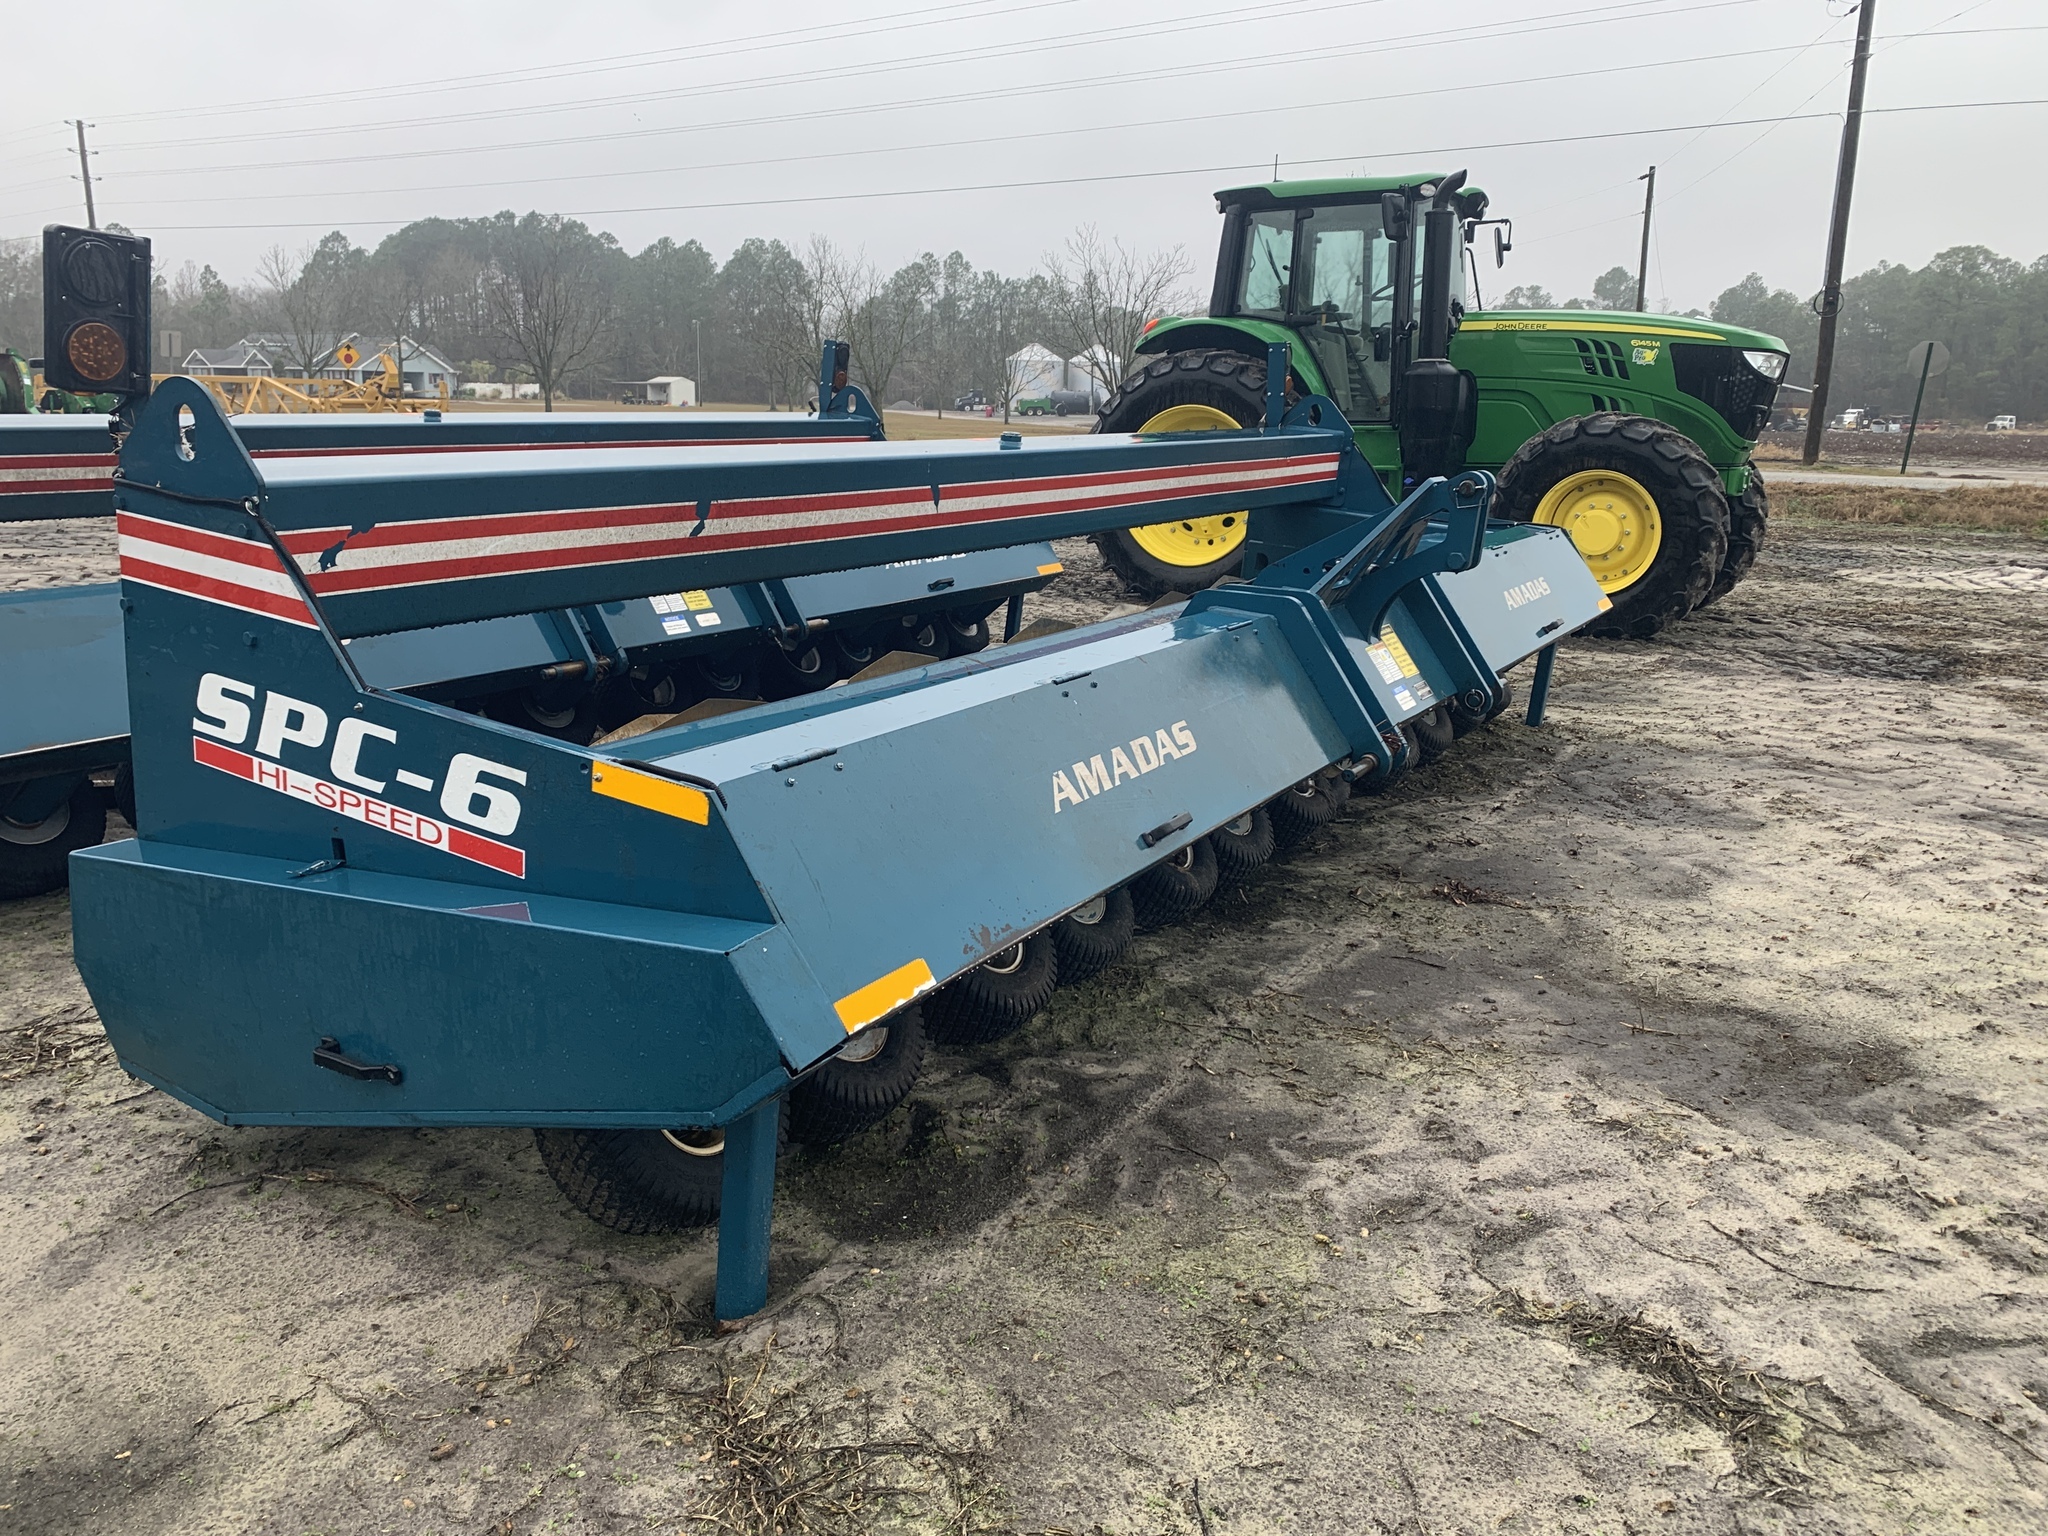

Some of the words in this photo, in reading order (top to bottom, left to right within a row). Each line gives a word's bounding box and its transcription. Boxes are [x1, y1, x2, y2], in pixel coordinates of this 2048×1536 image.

[1493, 322, 1517, 330] JOHN
[1518, 322, 1548, 330] DEERE
[1630, 339, 1661, 347] 6145M
[1503, 576, 1551, 610] AMADAS
[192, 672, 528, 836] SPC-6
[1052, 719, 1198, 814] AMADAS
[257, 761, 443, 845] HI-SPEED
